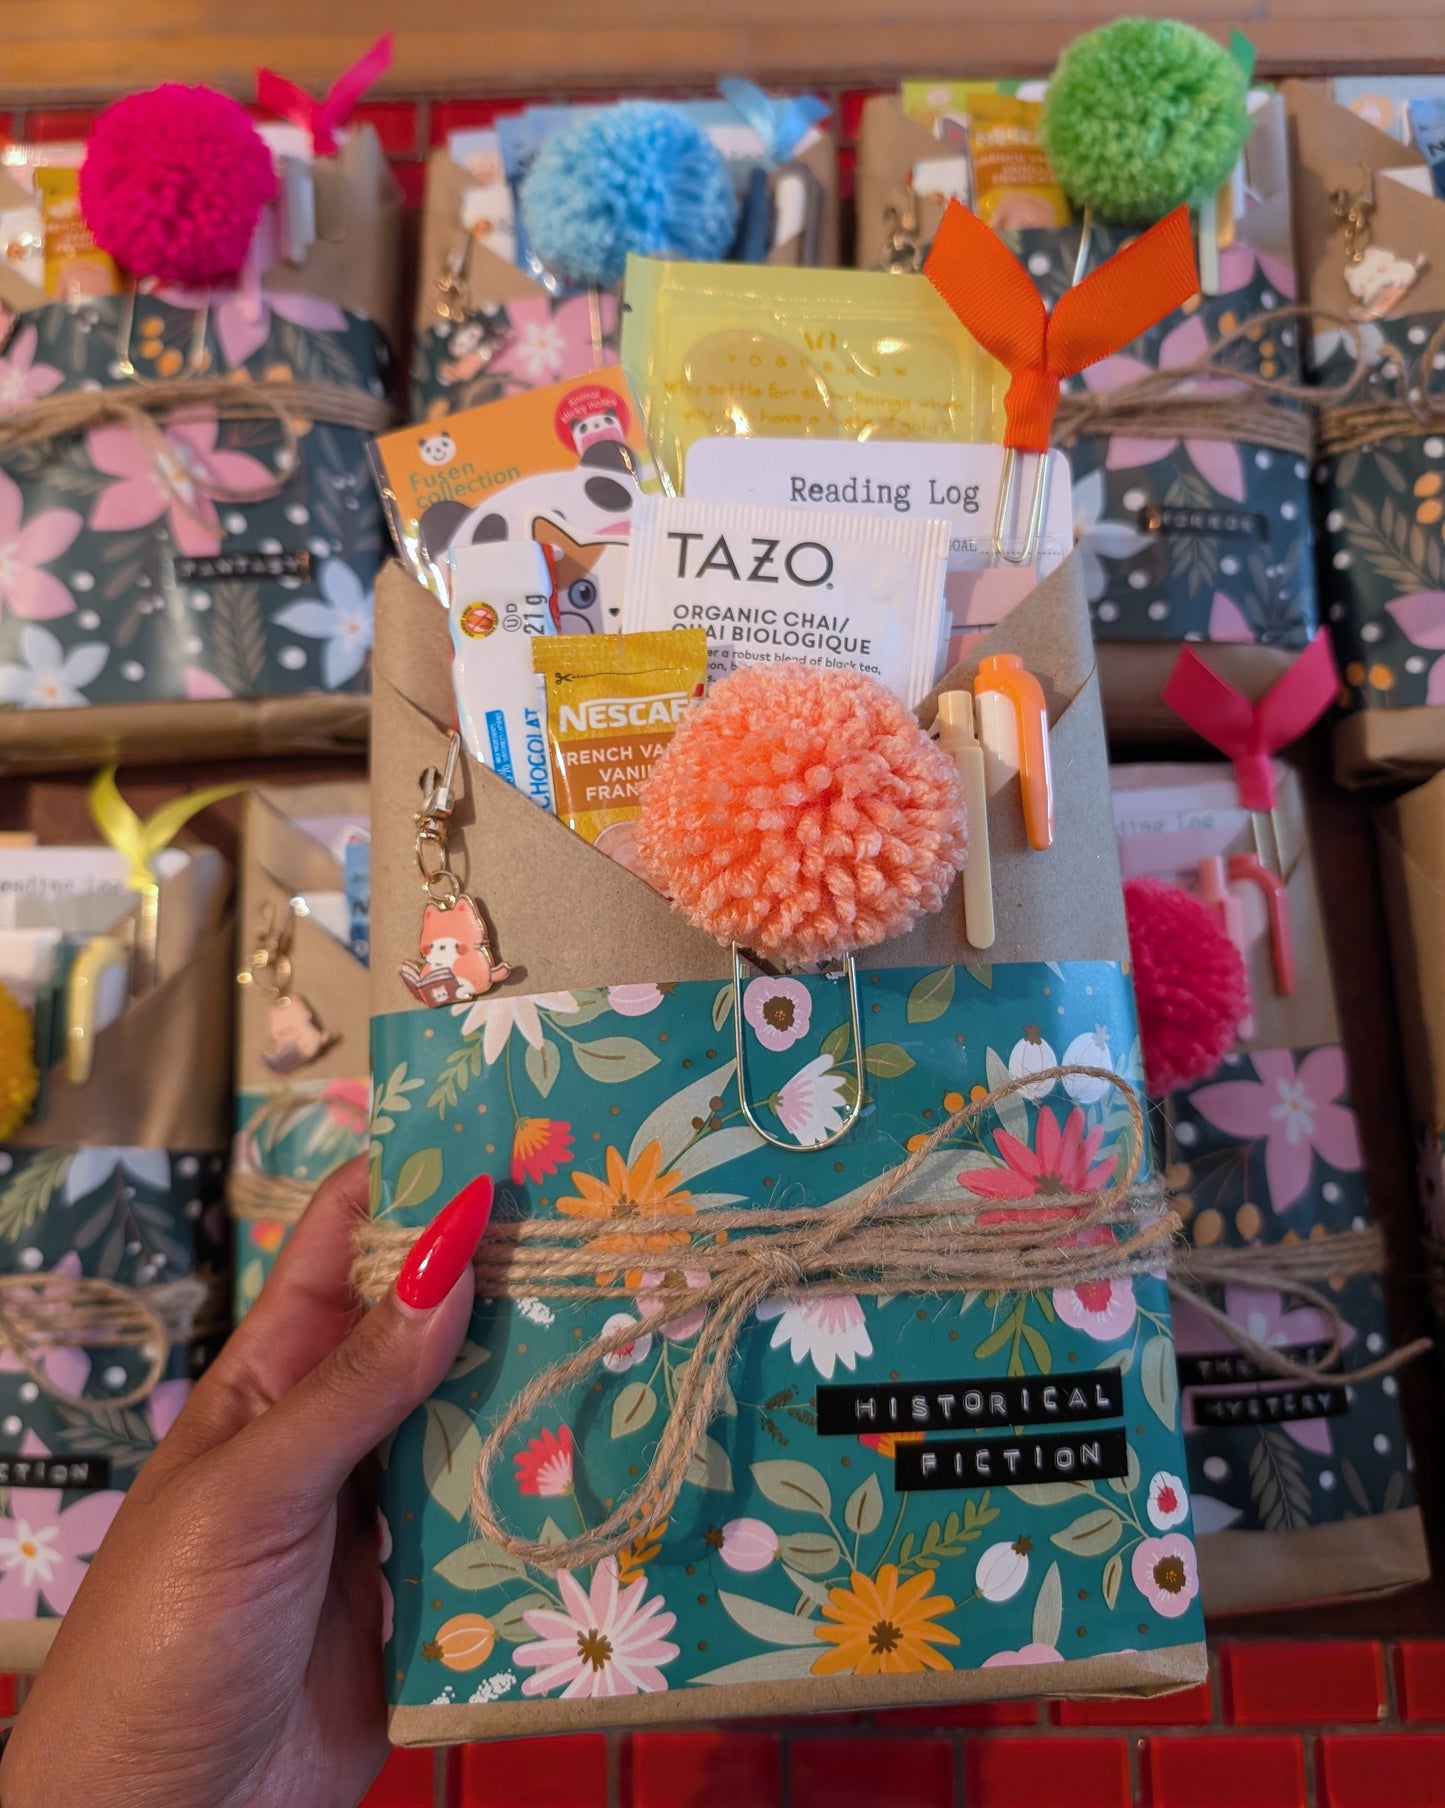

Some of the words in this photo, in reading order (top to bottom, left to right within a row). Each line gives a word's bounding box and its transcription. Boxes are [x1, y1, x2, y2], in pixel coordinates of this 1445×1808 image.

[408, 462, 475, 492] Fusen
[416, 466, 522, 509] collection
[789, 476, 911, 513] Reading
[929, 479, 980, 514] Log
[949, 539, 978, 552] OAL
[523, 614, 546, 636] 21
[673, 604, 777, 625] ORGANIC
[783, 611, 850, 634] CHAI/
[732, 626, 871, 655] BIOLOGIQUE
[721, 650, 730, 658] a
[732, 649, 771, 662] robust
[809, 656, 823, 666] of
[559, 691, 689, 733] NESCAF
[586, 783, 641, 802] FRAN
[854, 1382, 1111, 1422] HISTORICAL
[0, 1461, 90, 1483] CTION
[920, 1440, 1101, 1478] FICTION
